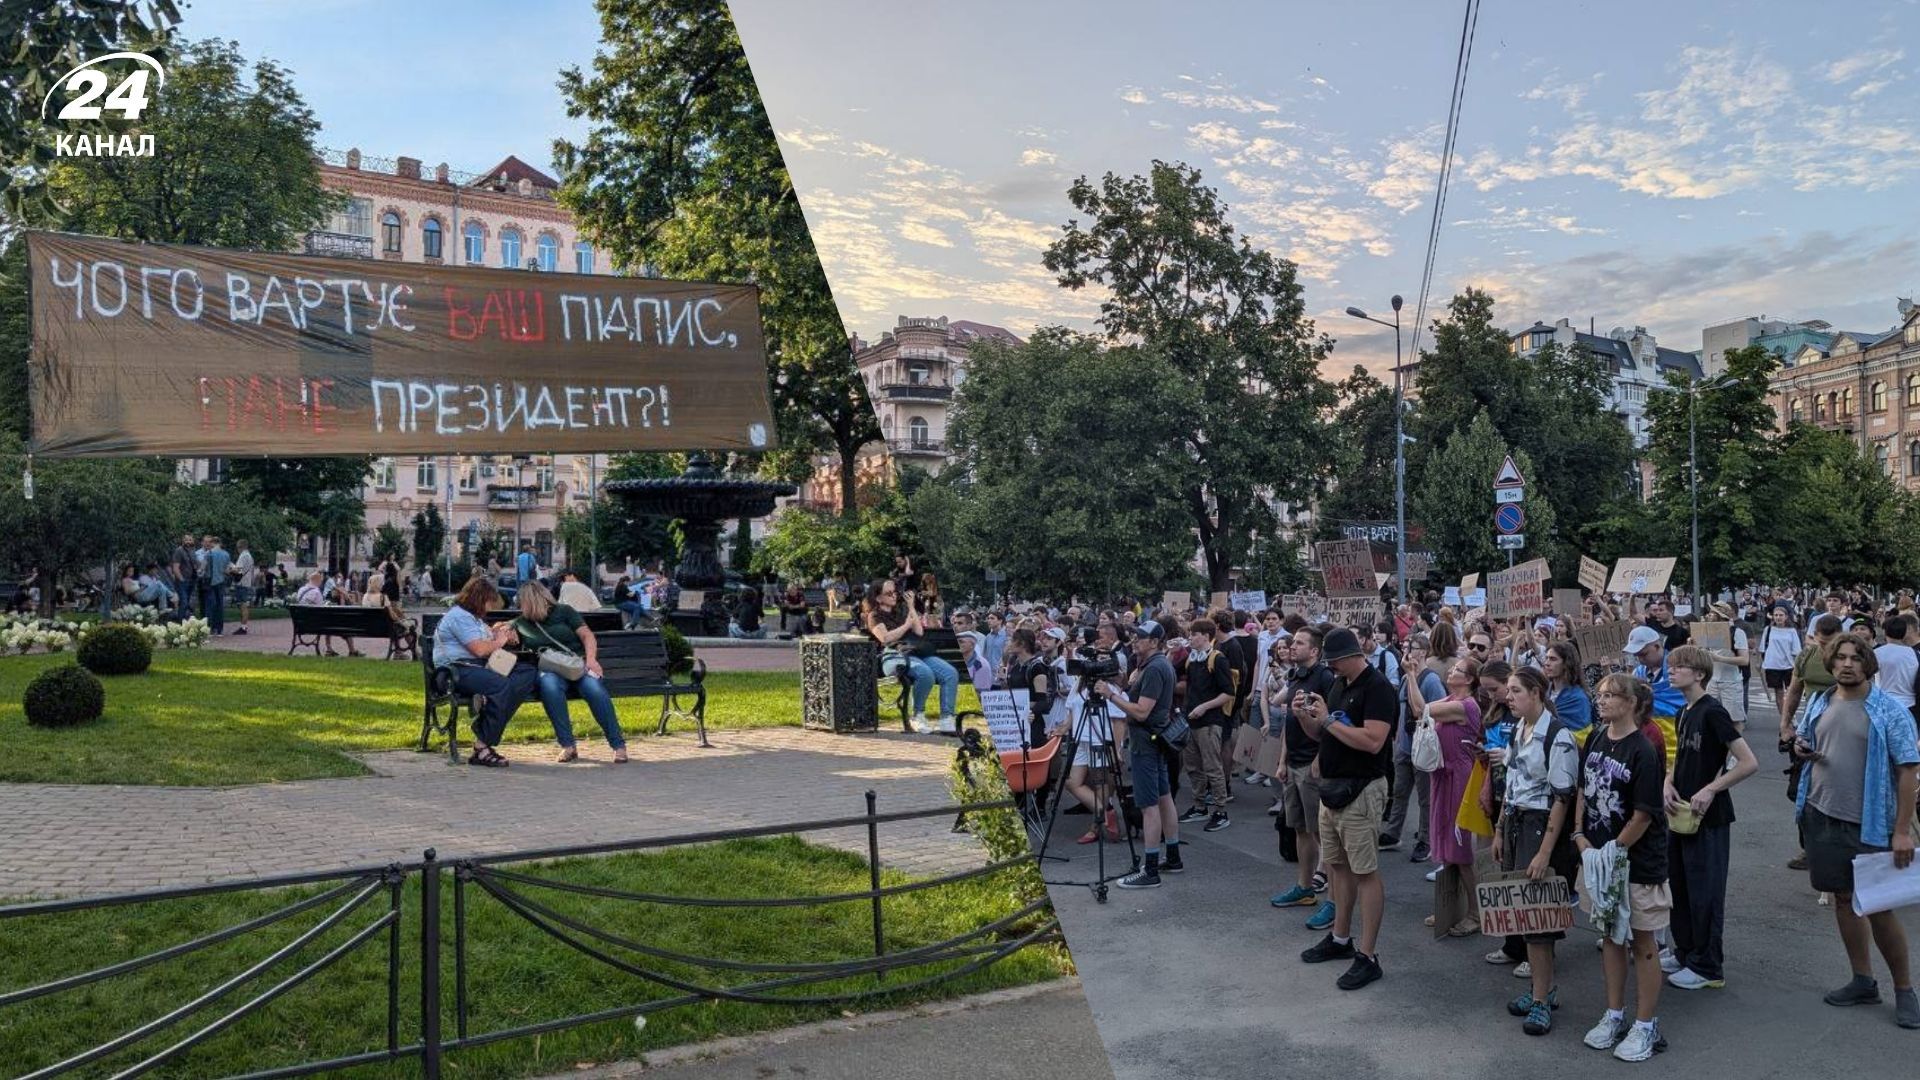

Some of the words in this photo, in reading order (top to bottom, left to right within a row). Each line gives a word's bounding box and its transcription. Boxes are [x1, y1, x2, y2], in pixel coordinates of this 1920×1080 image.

[51, 257, 205, 320] ЧОГО
[226, 271, 416, 335] ВАРТУЄ
[444, 285, 545, 342] ВАШ
[199, 376, 339, 434] ПАНЕ
[371, 379, 670, 434] ПРЕЗИДЕНТ?!
[1484, 911, 1494, 933] А
[1495, 910, 1513, 933] НЕ
